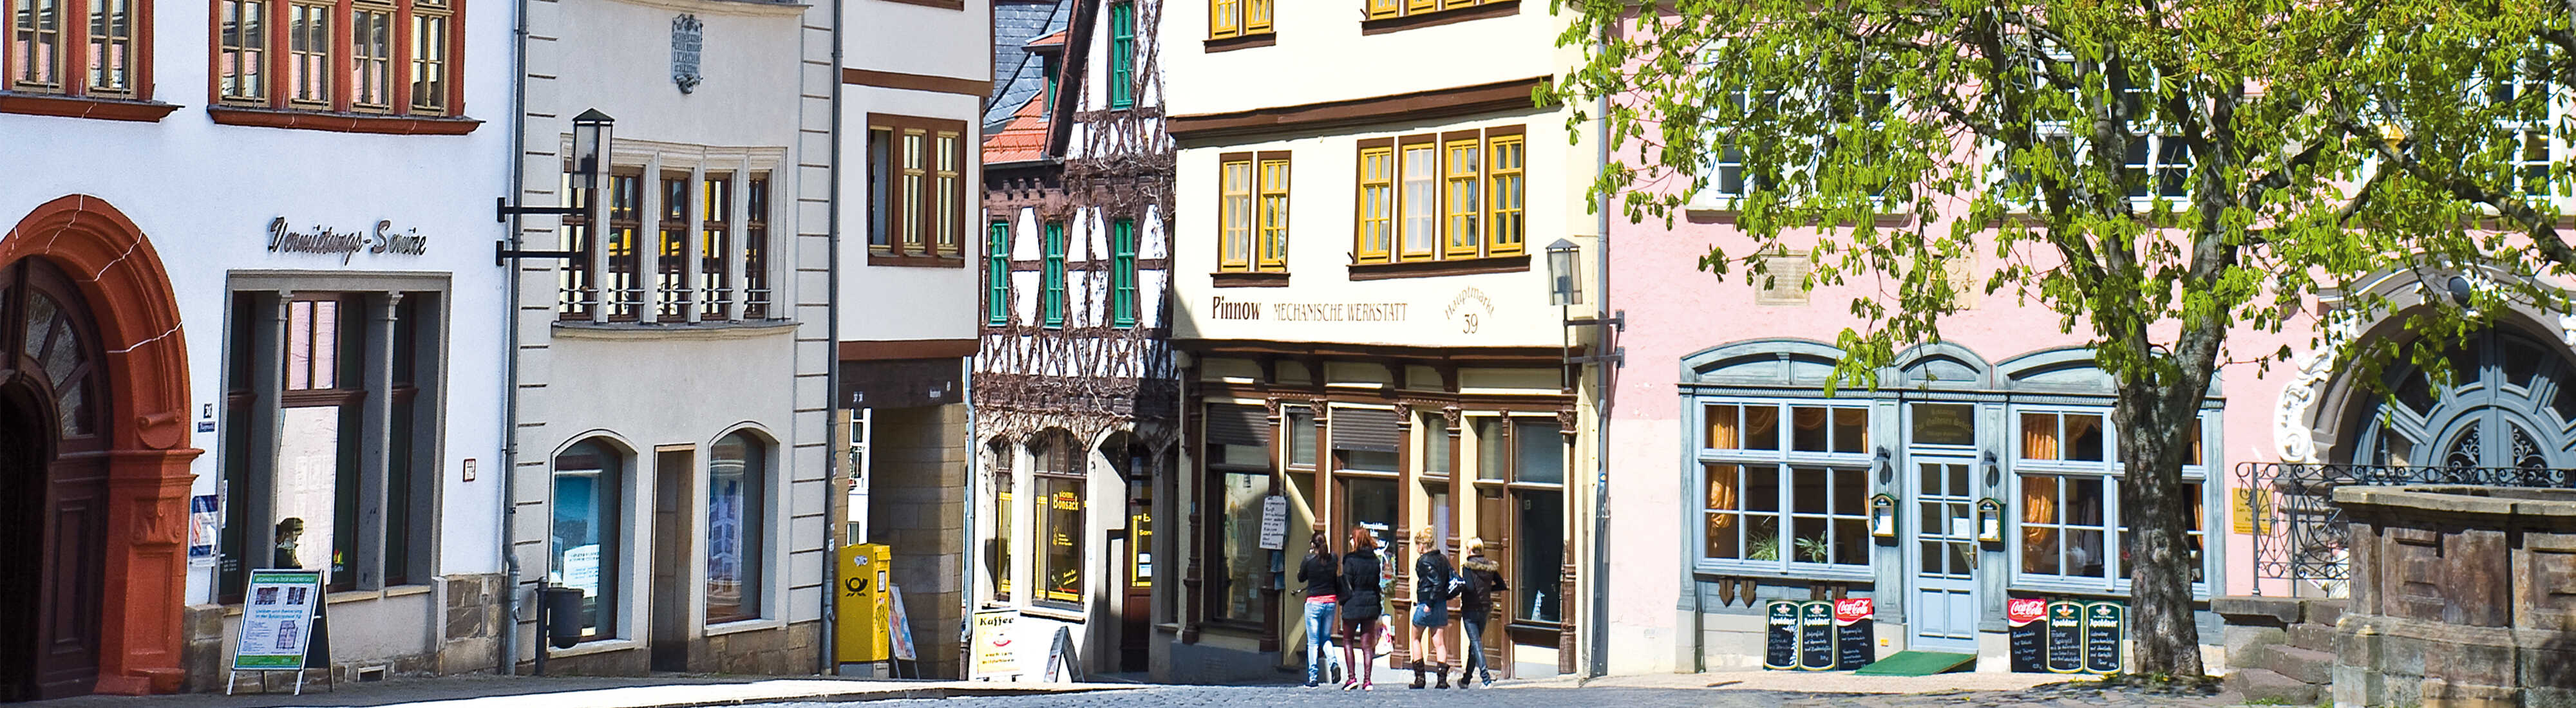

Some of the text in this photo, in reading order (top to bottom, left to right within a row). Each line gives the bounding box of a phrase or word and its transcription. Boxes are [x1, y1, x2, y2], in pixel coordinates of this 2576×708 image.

[1212, 295, 1408, 321] Pinnow MECHANISCHE WERKSTATT
[1445, 284, 1495, 320] Hauptmarkt
[1463, 313, 1478, 334] 39
[1053, 493, 1079, 510] Bonsack
[1837, 599, 1870, 615] Coca-Cola
[2011, 601, 2045, 616] Coca-Cola
[980, 616, 1014, 627] Kaffee
